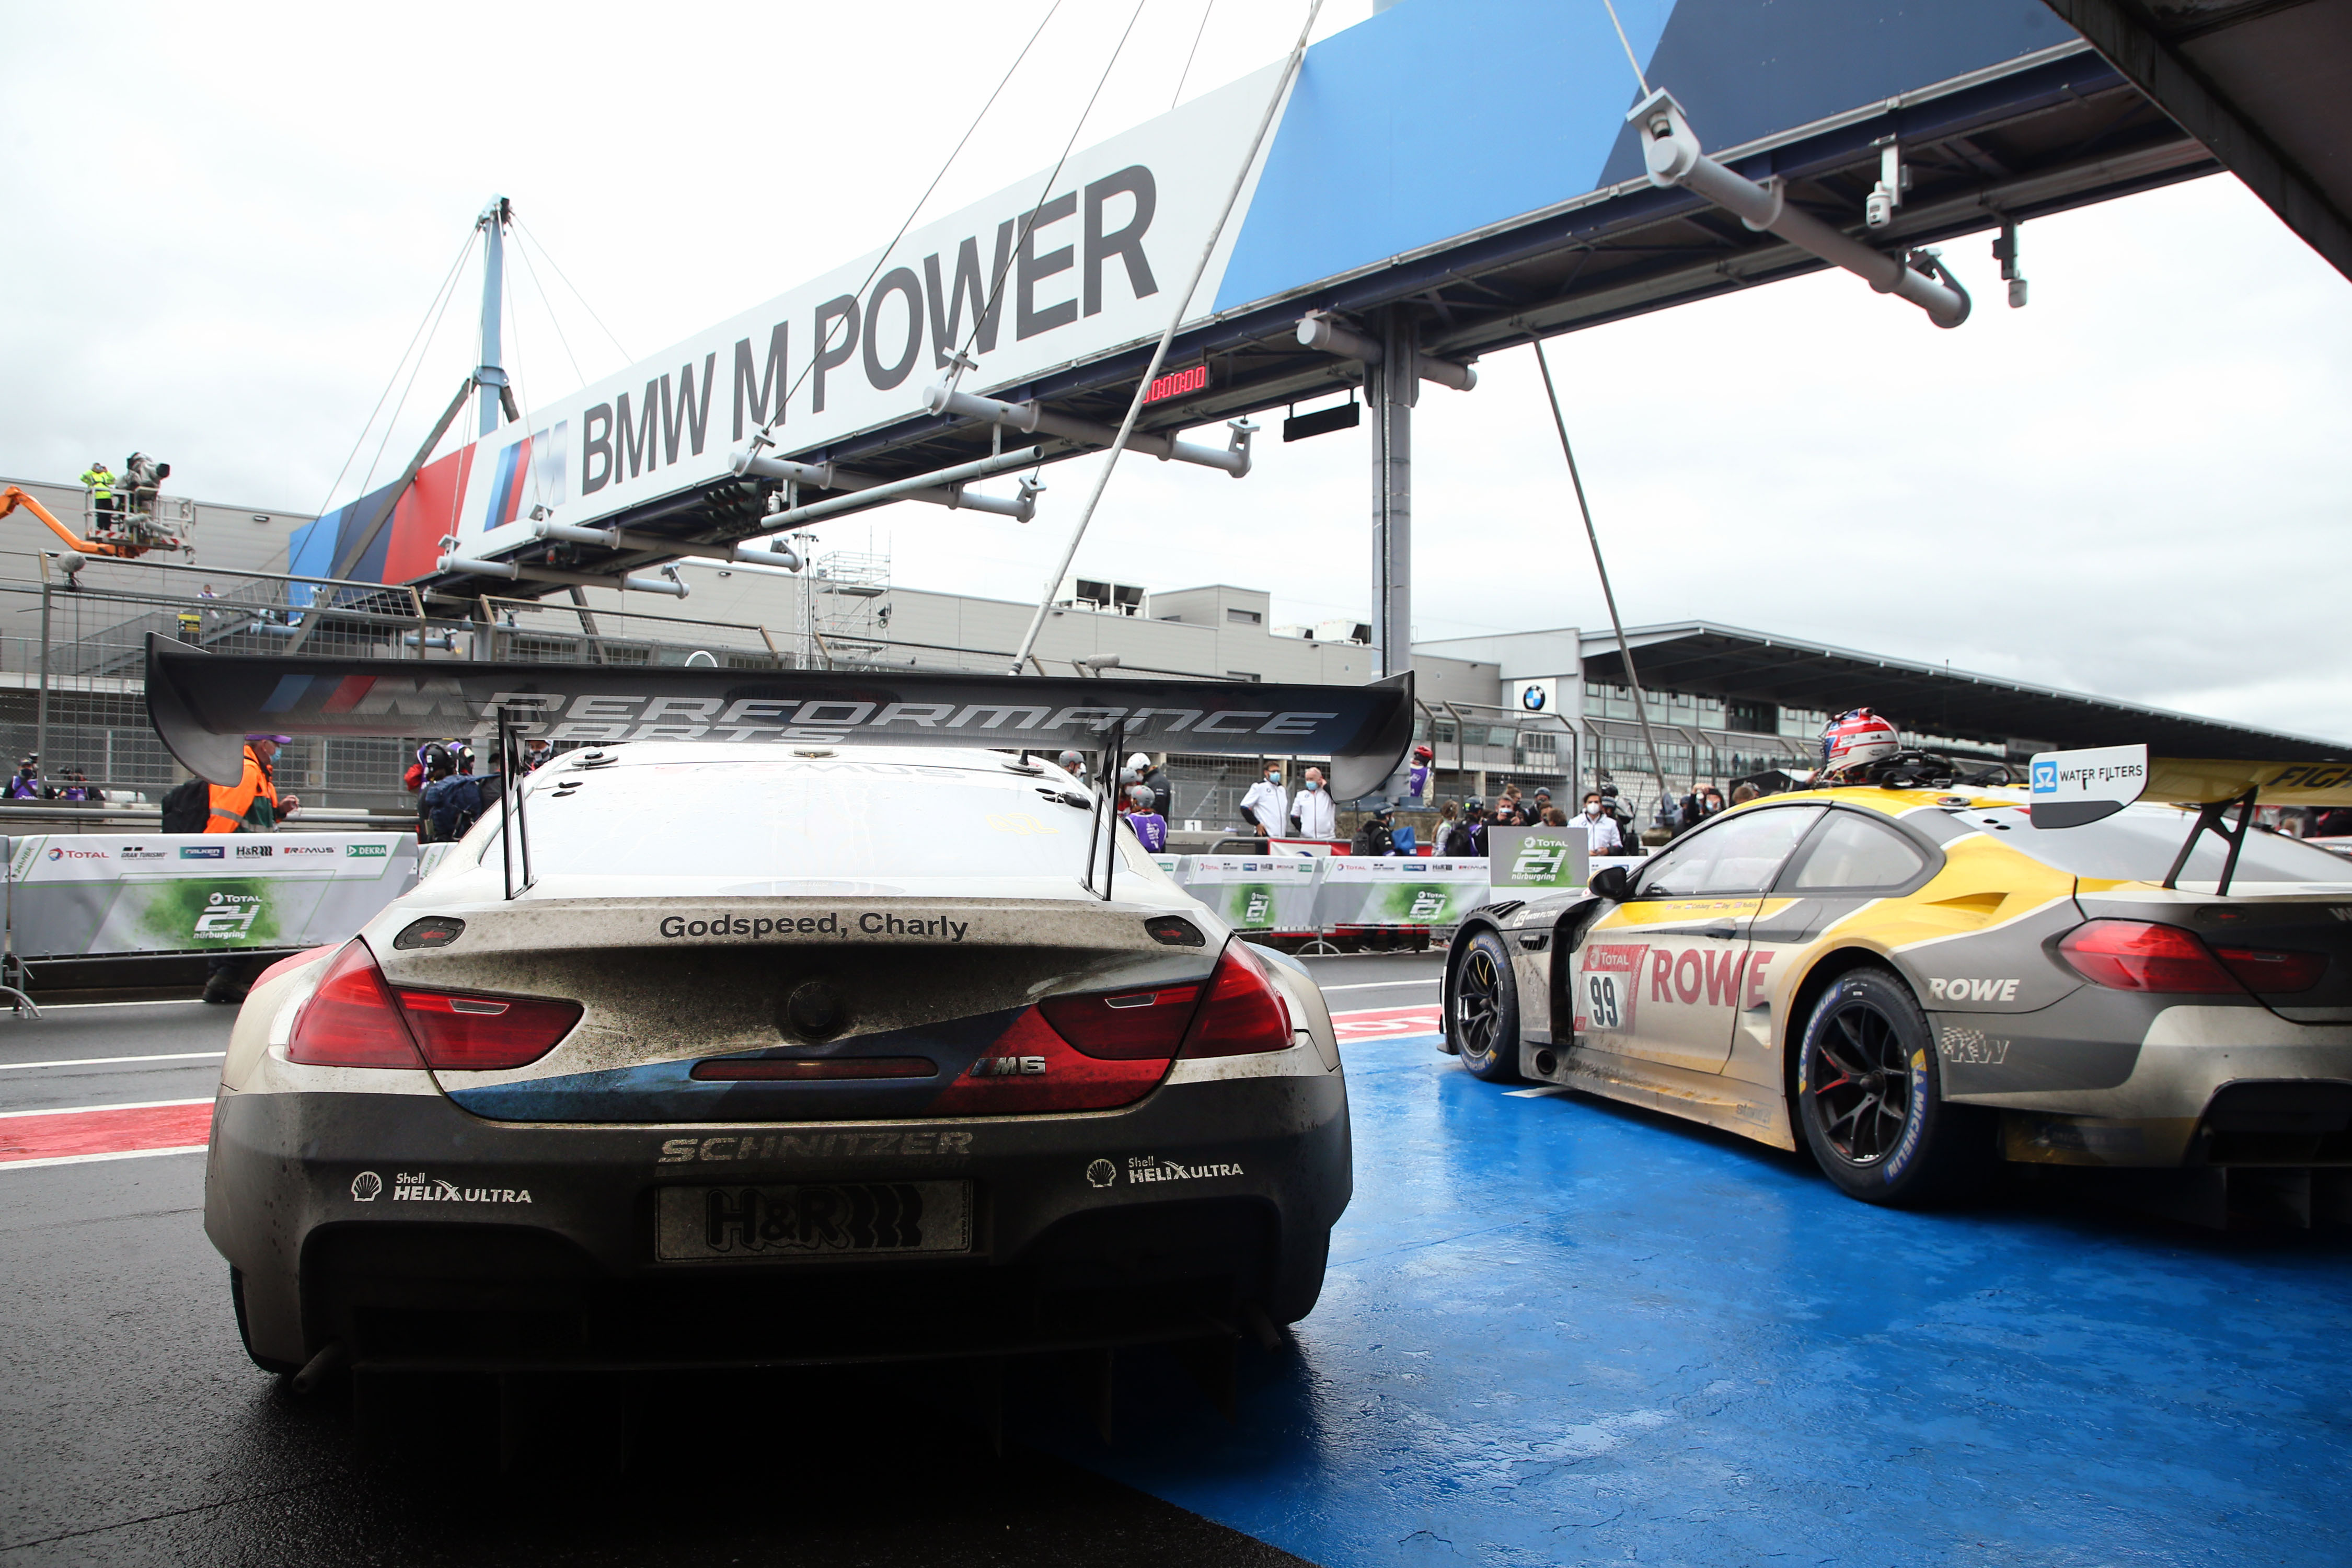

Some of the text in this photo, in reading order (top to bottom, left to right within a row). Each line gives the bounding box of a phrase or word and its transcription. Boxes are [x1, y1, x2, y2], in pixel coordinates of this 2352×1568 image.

[583, 165, 1159, 497] BMW M POWER
[481, 691, 1343, 735] PERFORMANCE
[2060, 765, 2142, 781] WATER FILTERS
[66, 850, 109, 859] TOTAL
[236, 846, 260, 856] H&R
[359, 846, 386, 855] DEKRA
[1537, 838, 1568, 847] TOTAL
[1513, 849, 1566, 873] 24
[1512, 872, 1556, 882] nürburgring
[194, 905, 260, 931] 24
[660, 912, 969, 942] Godspeed, Charly
[193, 930, 246, 940] nürburgring
[1477, 936, 1503, 965] MICHELIN
[1601, 952, 1630, 965] TOTAL
[1651, 949, 1777, 1009] ROWE
[1928, 977, 2021, 1001] ROWE
[1590, 976, 1618, 1027] 99
[1801, 987, 1838, 1060] MICHELIN
[1950, 1037, 2010, 1064] KW
[994, 1056, 1046, 1075] M6
[1887, 1090, 1926, 1178] MICHELIN
[657, 1132, 974, 1163] SCHNITZER
[1128, 1155, 1154, 1168] Shell
[1128, 1161, 1244, 1184] HELIX ULTRA
[396, 1172, 425, 1184] Shell
[393, 1179, 533, 1203] HELIX ULTRA
[708, 1189, 846, 1249] H&R
